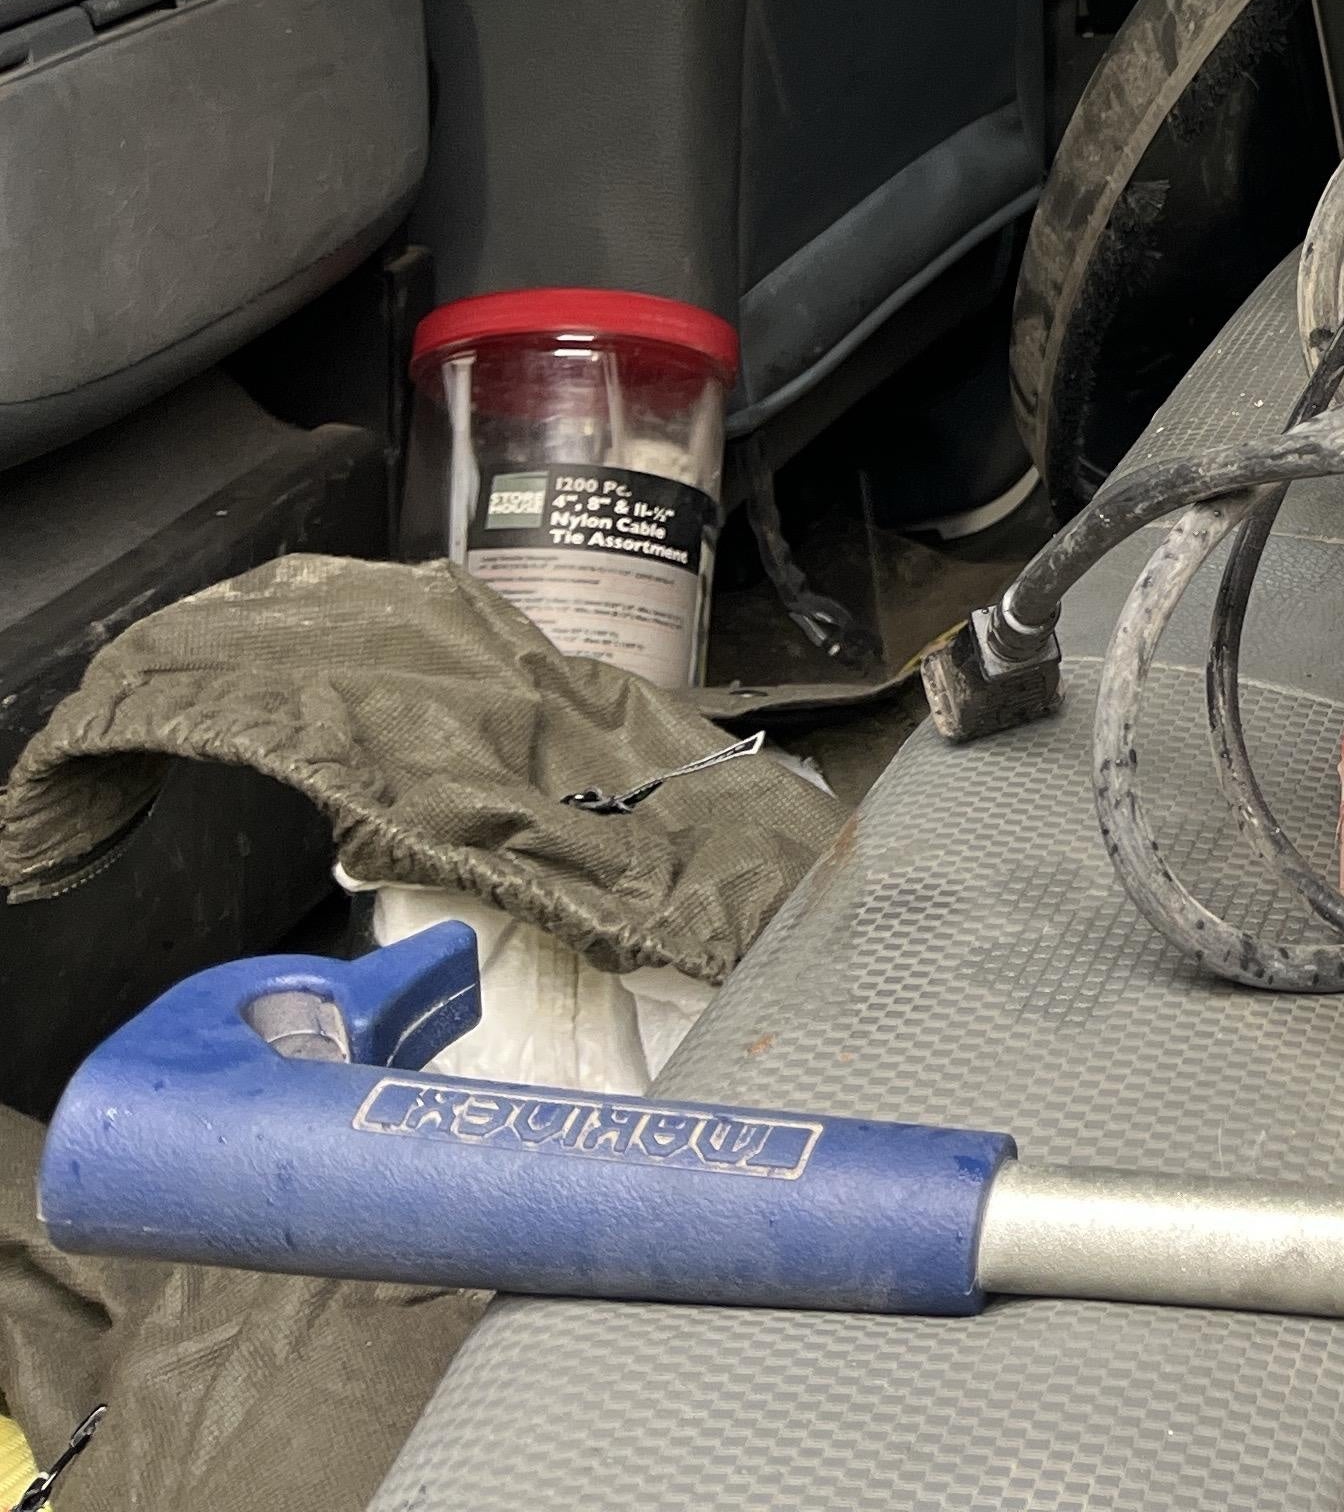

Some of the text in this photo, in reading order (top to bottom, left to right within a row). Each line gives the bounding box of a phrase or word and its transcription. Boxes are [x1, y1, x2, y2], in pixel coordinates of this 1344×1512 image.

[554, 476, 599, 493] 1200
[613, 498, 631, 517] &
[550, 510, 667, 541] Nylon Cable
[549, 528, 689, 565] Tie Assortment
[404, 1086, 774, 1166] MAKINEX
